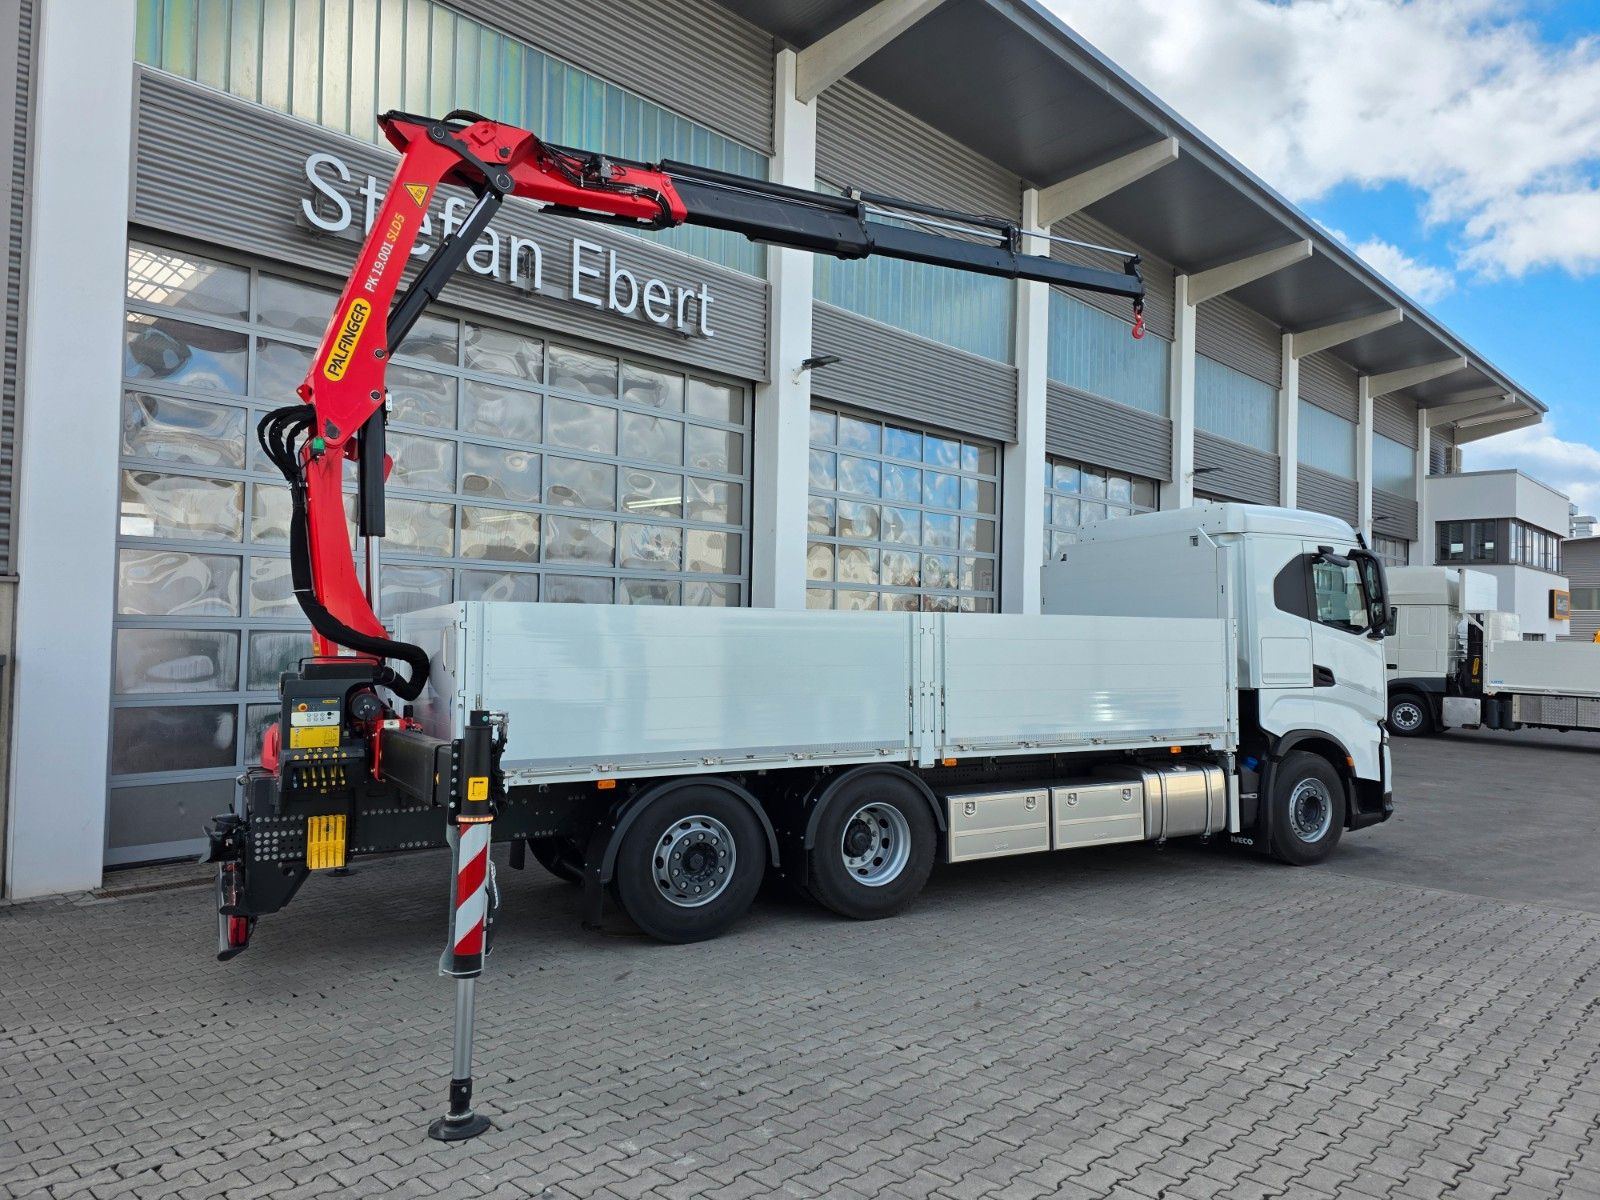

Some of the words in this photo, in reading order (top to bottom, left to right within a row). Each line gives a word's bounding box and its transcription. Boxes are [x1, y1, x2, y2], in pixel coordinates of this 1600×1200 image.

[364, 275, 380, 293] PK
[372, 242, 394, 276] 19.001
[386, 212, 405, 242] SLD5
[573, 238, 714, 337] Ebert
[327, 303, 368, 377] PALFINGER
[1230, 835, 1254, 846] IVECO
